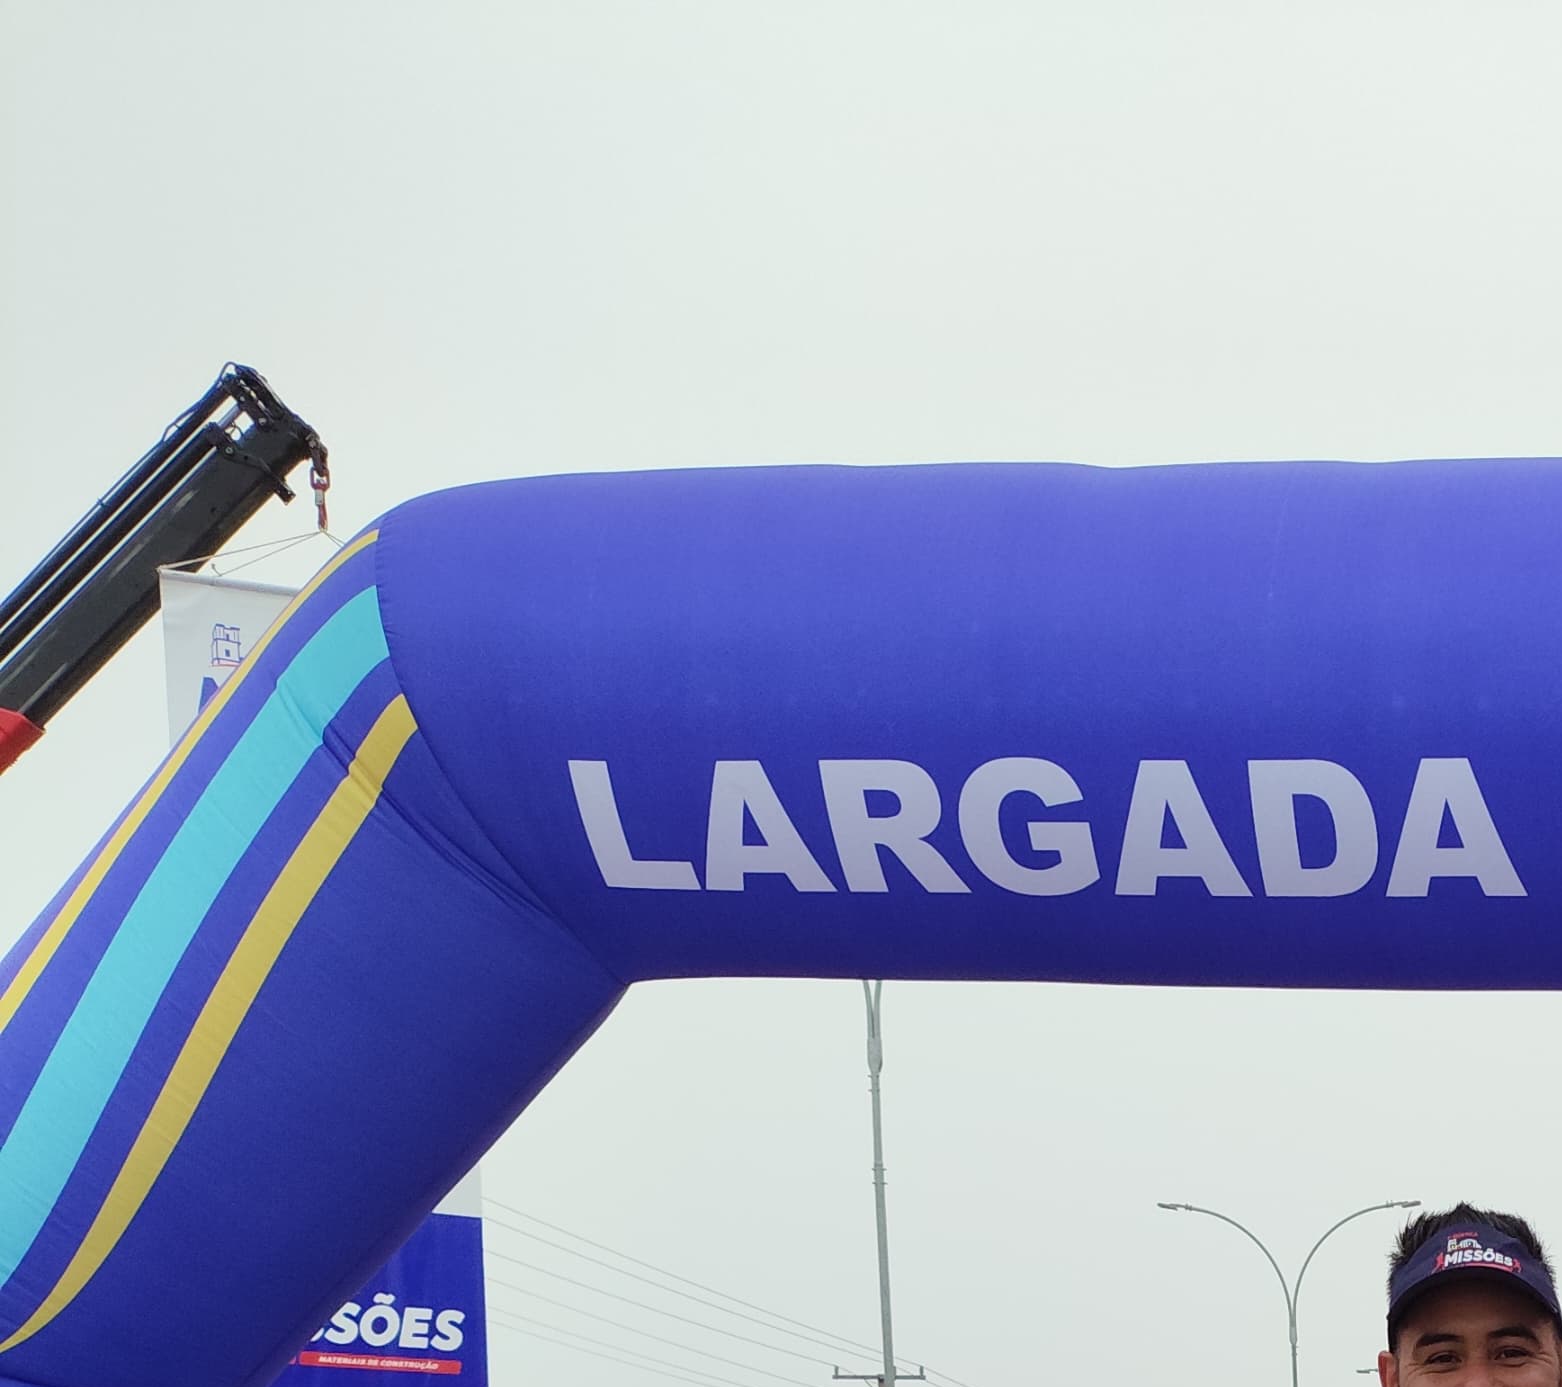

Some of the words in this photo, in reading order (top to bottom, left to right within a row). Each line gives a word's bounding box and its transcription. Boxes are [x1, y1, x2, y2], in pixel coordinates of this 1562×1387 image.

[567, 757, 1528, 899] LARGADA
[1444, 1248, 1513, 1267] MISSÕES
[311, 1293, 466, 1351] SÕES
